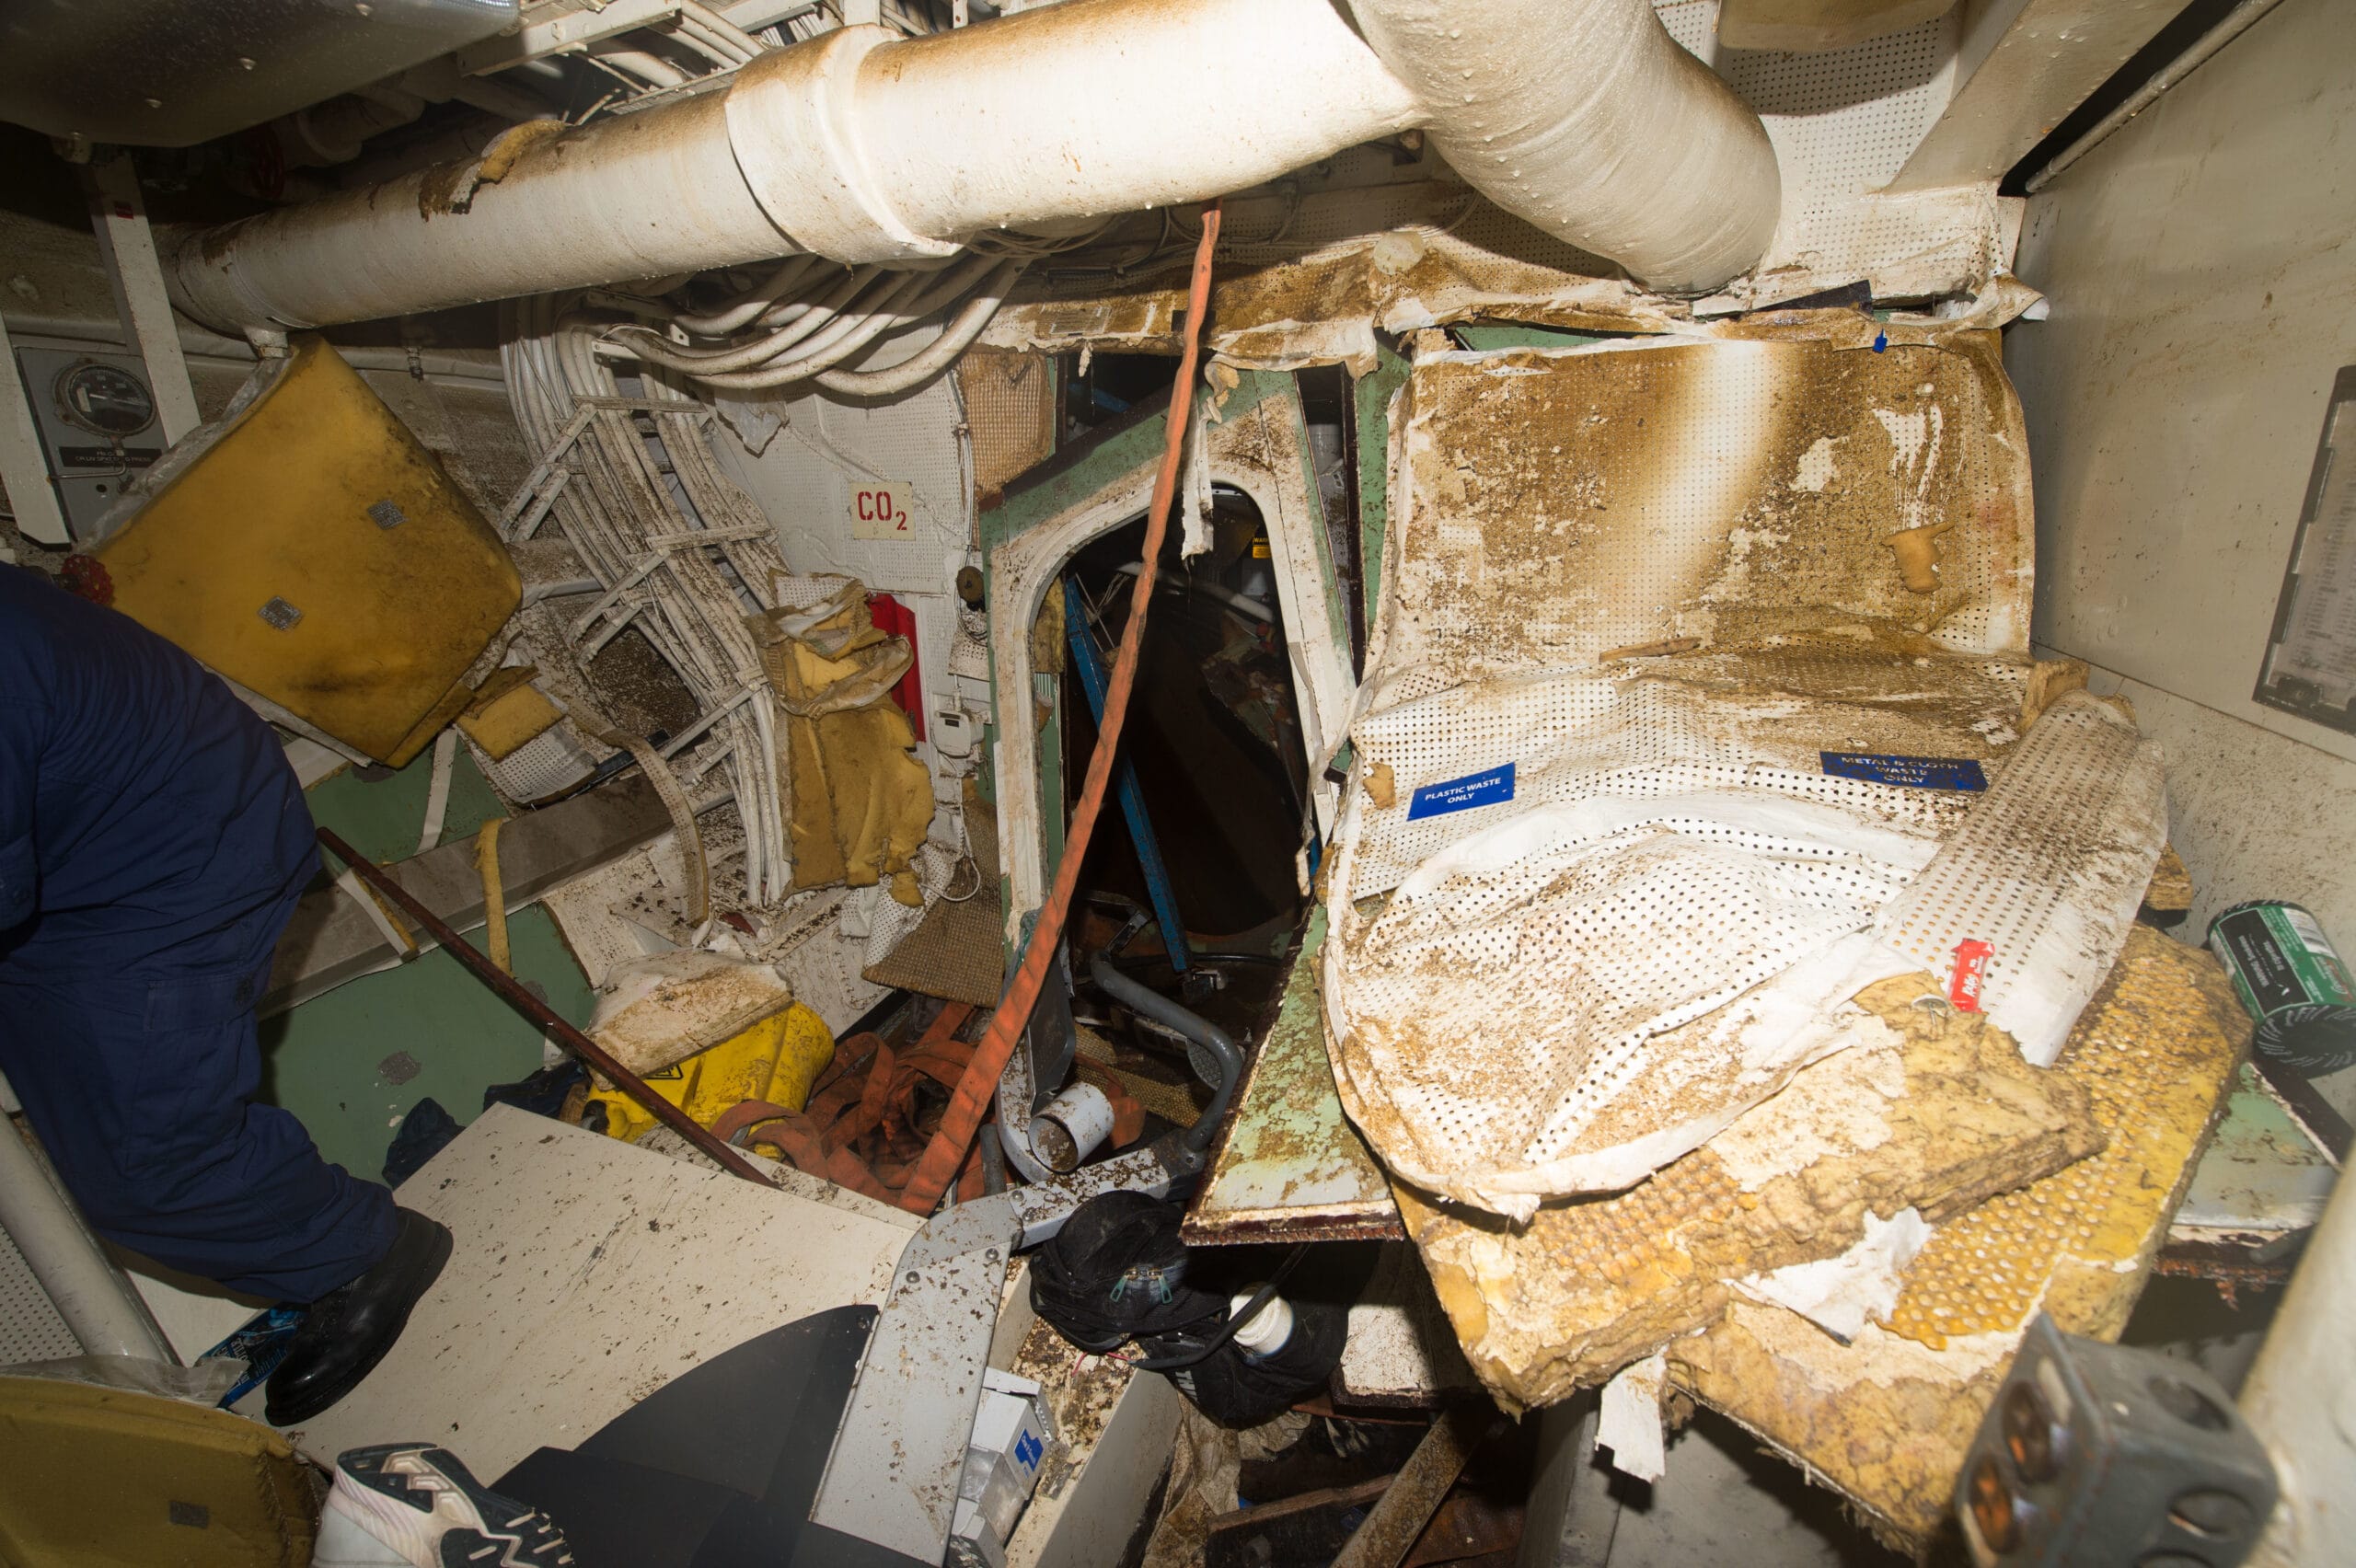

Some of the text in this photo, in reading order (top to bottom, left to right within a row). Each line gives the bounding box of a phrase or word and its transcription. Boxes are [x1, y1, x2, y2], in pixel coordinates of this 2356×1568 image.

[857, 490, 907, 531] CO2
[1842, 756, 1888, 766] METAL
[1909, 760, 1958, 769] CLOTH
[1875, 766, 1928, 776] WASTE
[1883, 775, 1925, 783] ONLY
[1425, 778, 1501, 801] PLASTIC WASTE
[1448, 791, 1474, 804] ONLY
